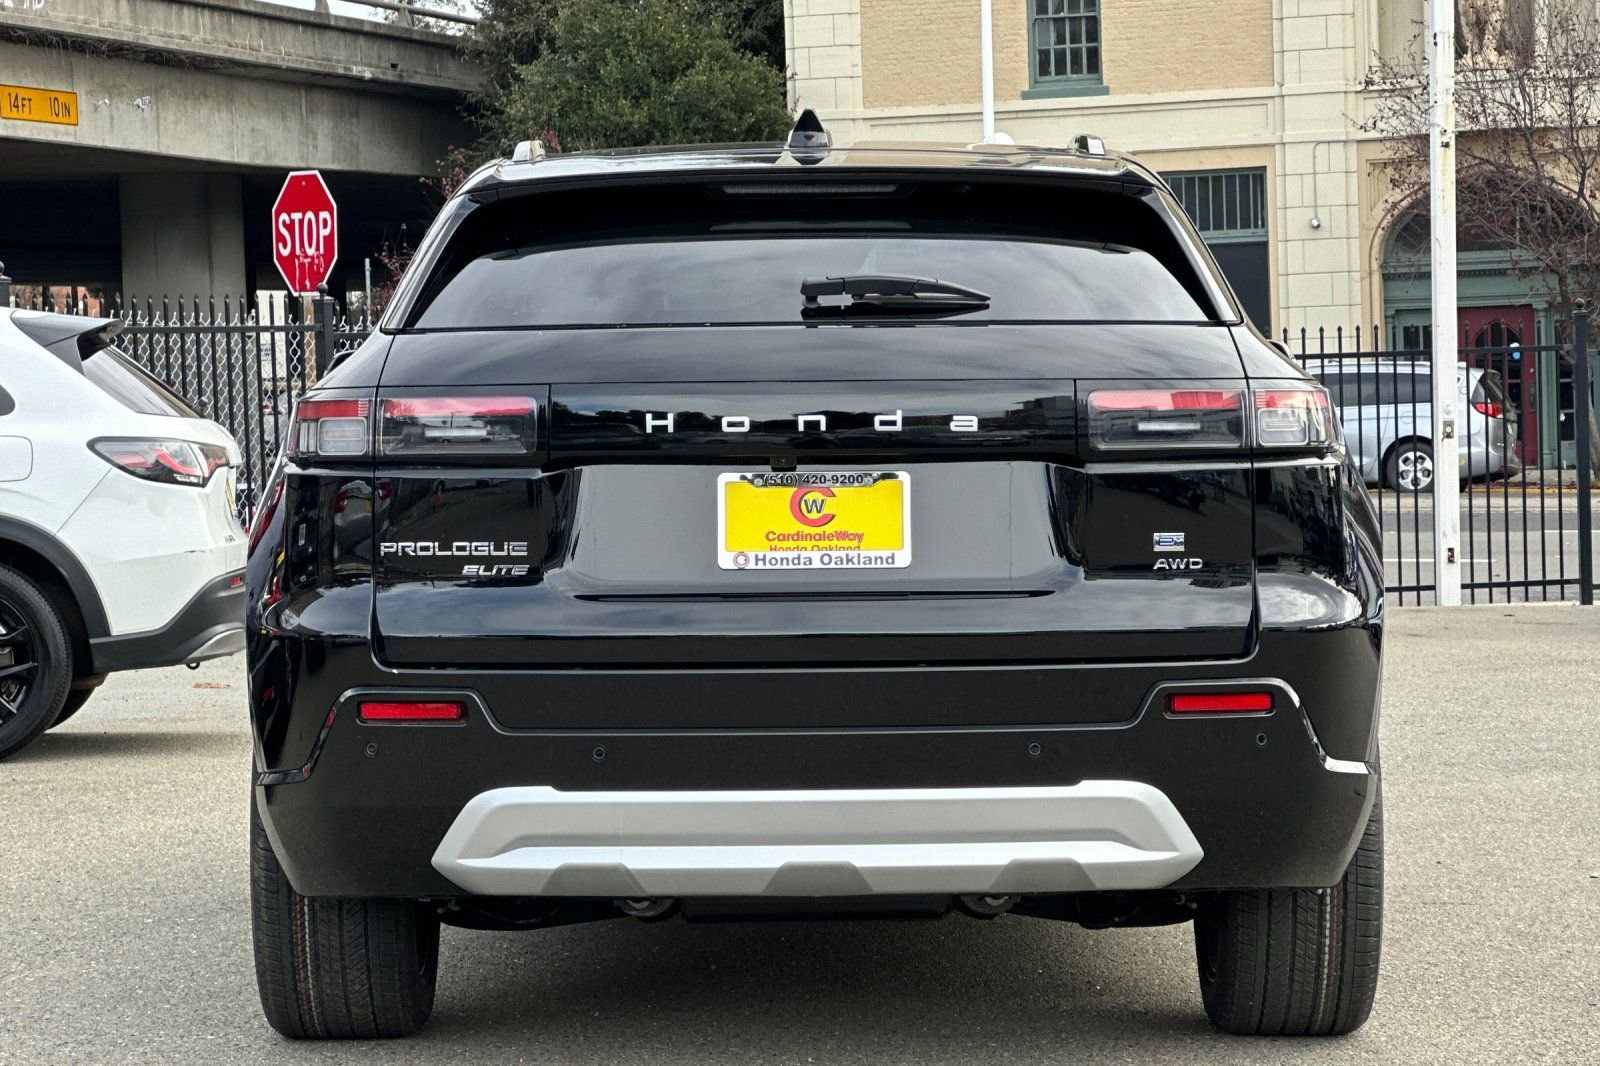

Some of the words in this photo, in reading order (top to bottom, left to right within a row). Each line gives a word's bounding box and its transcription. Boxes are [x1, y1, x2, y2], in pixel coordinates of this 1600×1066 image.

[8, 92, 32, 114] 14FT
[49, 97, 71, 118] 10IN
[278, 210, 332, 256] STOP
[645, 410, 979, 433] Honda
[764, 474, 798, 487] (510)
[803, 474, 864, 484] 420-9200
[765, 530, 864, 543] CardinaleWay
[380, 541, 528, 556] PROLOGUE
[754, 554, 813, 566] Honda
[819, 553, 896, 566] Oakland
[1153, 558, 1204, 570] AWD
[461, 564, 530, 576] ELITE
